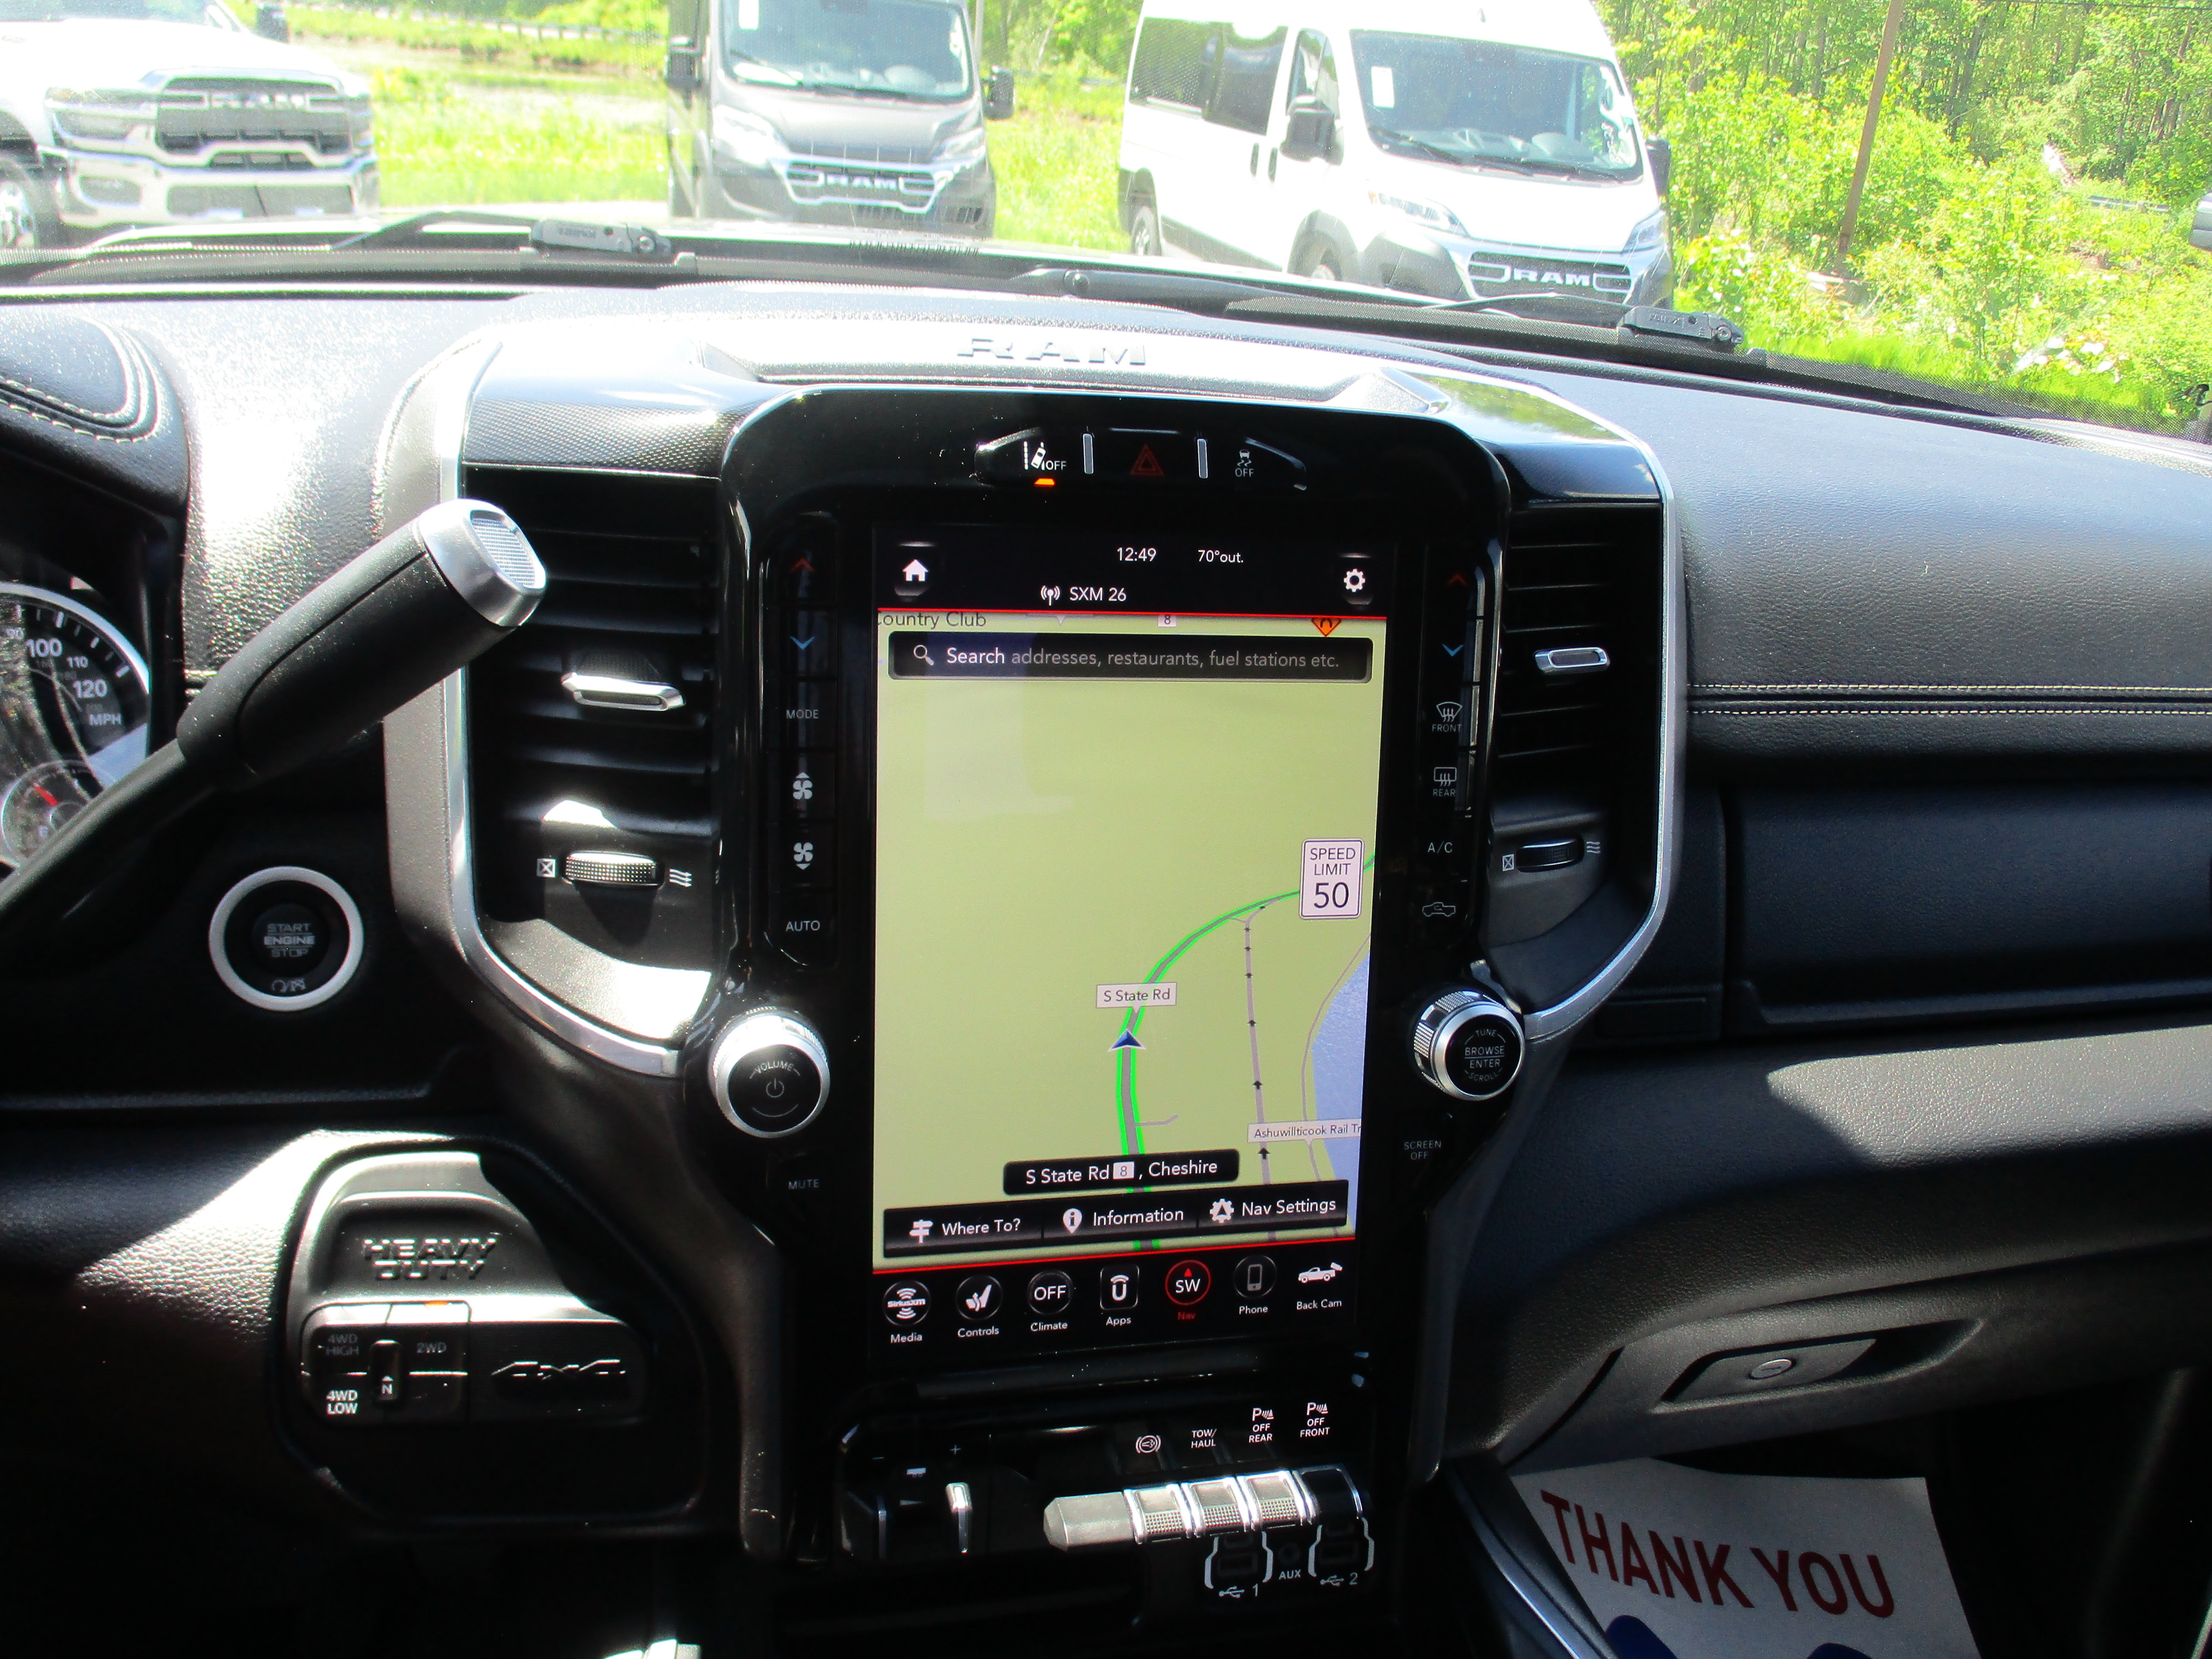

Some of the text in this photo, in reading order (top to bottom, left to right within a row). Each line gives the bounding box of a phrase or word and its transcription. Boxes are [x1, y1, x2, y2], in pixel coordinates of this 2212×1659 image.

[827, 174, 897, 190] RAM
[1513, 268, 1590, 286] RAM
[957, 338, 1146, 365] RAM
[1047, 460, 1066, 470] OFF
[1235, 468, 1254, 477] OFF
[1116, 548, 1157, 562] 12:49
[1198, 550, 1244, 564] 70°out.
[1070, 588, 1126, 602] SXM 26
[946, 612, 987, 628] Club
[1164, 615, 1171, 625] 8
[27, 638, 62, 657] 100
[67, 657, 88, 668] 110
[947, 648, 1339, 668] Search addresses, restaurants, fuel stations etc.
[73, 680, 108, 698] 120
[89, 714, 122, 725] MPH
[786, 710, 819, 719] MODE
[1428, 841, 1452, 854] A/C
[1310, 848, 1355, 860] SPEED
[1314, 863, 1351, 875] LIMIT
[1313, 882, 1349, 909] 50
[267, 923, 311, 933] START
[786, 921, 820, 932] AUTO
[264, 936, 315, 945] ENGINE
[271, 948, 308, 957] STOP
[1104, 989, 1170, 1001] S State Rd
[1465, 1046, 1504, 1056] BROWSE
[756, 1061, 794, 1073] VOLUME
[1470, 1060, 1500, 1069] ENTER
[1468, 1072, 1498, 1082] SCROLL
[1254, 1126, 1326, 1138] Ashuwillticook
[1330, 1125, 1347, 1135] Rail
[1404, 1140, 1441, 1150] SCREEN
[1410, 1152, 1428, 1160] OFF
[1026, 1170, 1036, 1184] S
[1041, 1168, 1081, 1183] State
[1088, 1165, 1109, 1181] Rd
[1149, 1161, 1217, 1177] Cheshire
[789, 1179, 819, 1190] MUTE
[1241, 1199, 1336, 1217] Nav Settings
[1093, 1209, 1183, 1226] Information
[942, 1219, 1021, 1236] Where To?
[363, 1238, 497, 1260] HEAVY
[374, 1260, 486, 1280] DUTY
[1176, 1279, 1200, 1293] SW
[1034, 1285, 1066, 1301] OFF
[1239, 1304, 1267, 1315] Phone
[1296, 1299, 1342, 1310] Back Cam
[1106, 1316, 1131, 1327] Apps
[1177, 1312, 1195, 1321] Nav
[958, 1325, 999, 1337] Controls
[1031, 1321, 1067, 1332] Climate
[328, 1334, 358, 1345] 4WD
[890, 1332, 922, 1344] Media
[326, 1345, 360, 1356] HIGH
[417, 1343, 446, 1353] 2WD
[382, 1384, 392, 1395] N
[326, 1390, 358, 1402] 4WD
[327, 1402, 358, 1415] LOW
[1252, 1423, 1270, 1432] OFF
[1307, 1418, 1325, 1426] OFF
[1192, 1428, 1216, 1438] TOW/
[1300, 1428, 1330, 1437] FRONT
[1191, 1439, 1215, 1448] HAUL
[1249, 1434, 1273, 1443] REAR
[1540, 1489, 1894, 1617] THANK YOU
[1279, 1569, 1300, 1579] AUX
[1350, 1573, 1358, 1584] 2
[1253, 1584, 1258, 1596] 1
